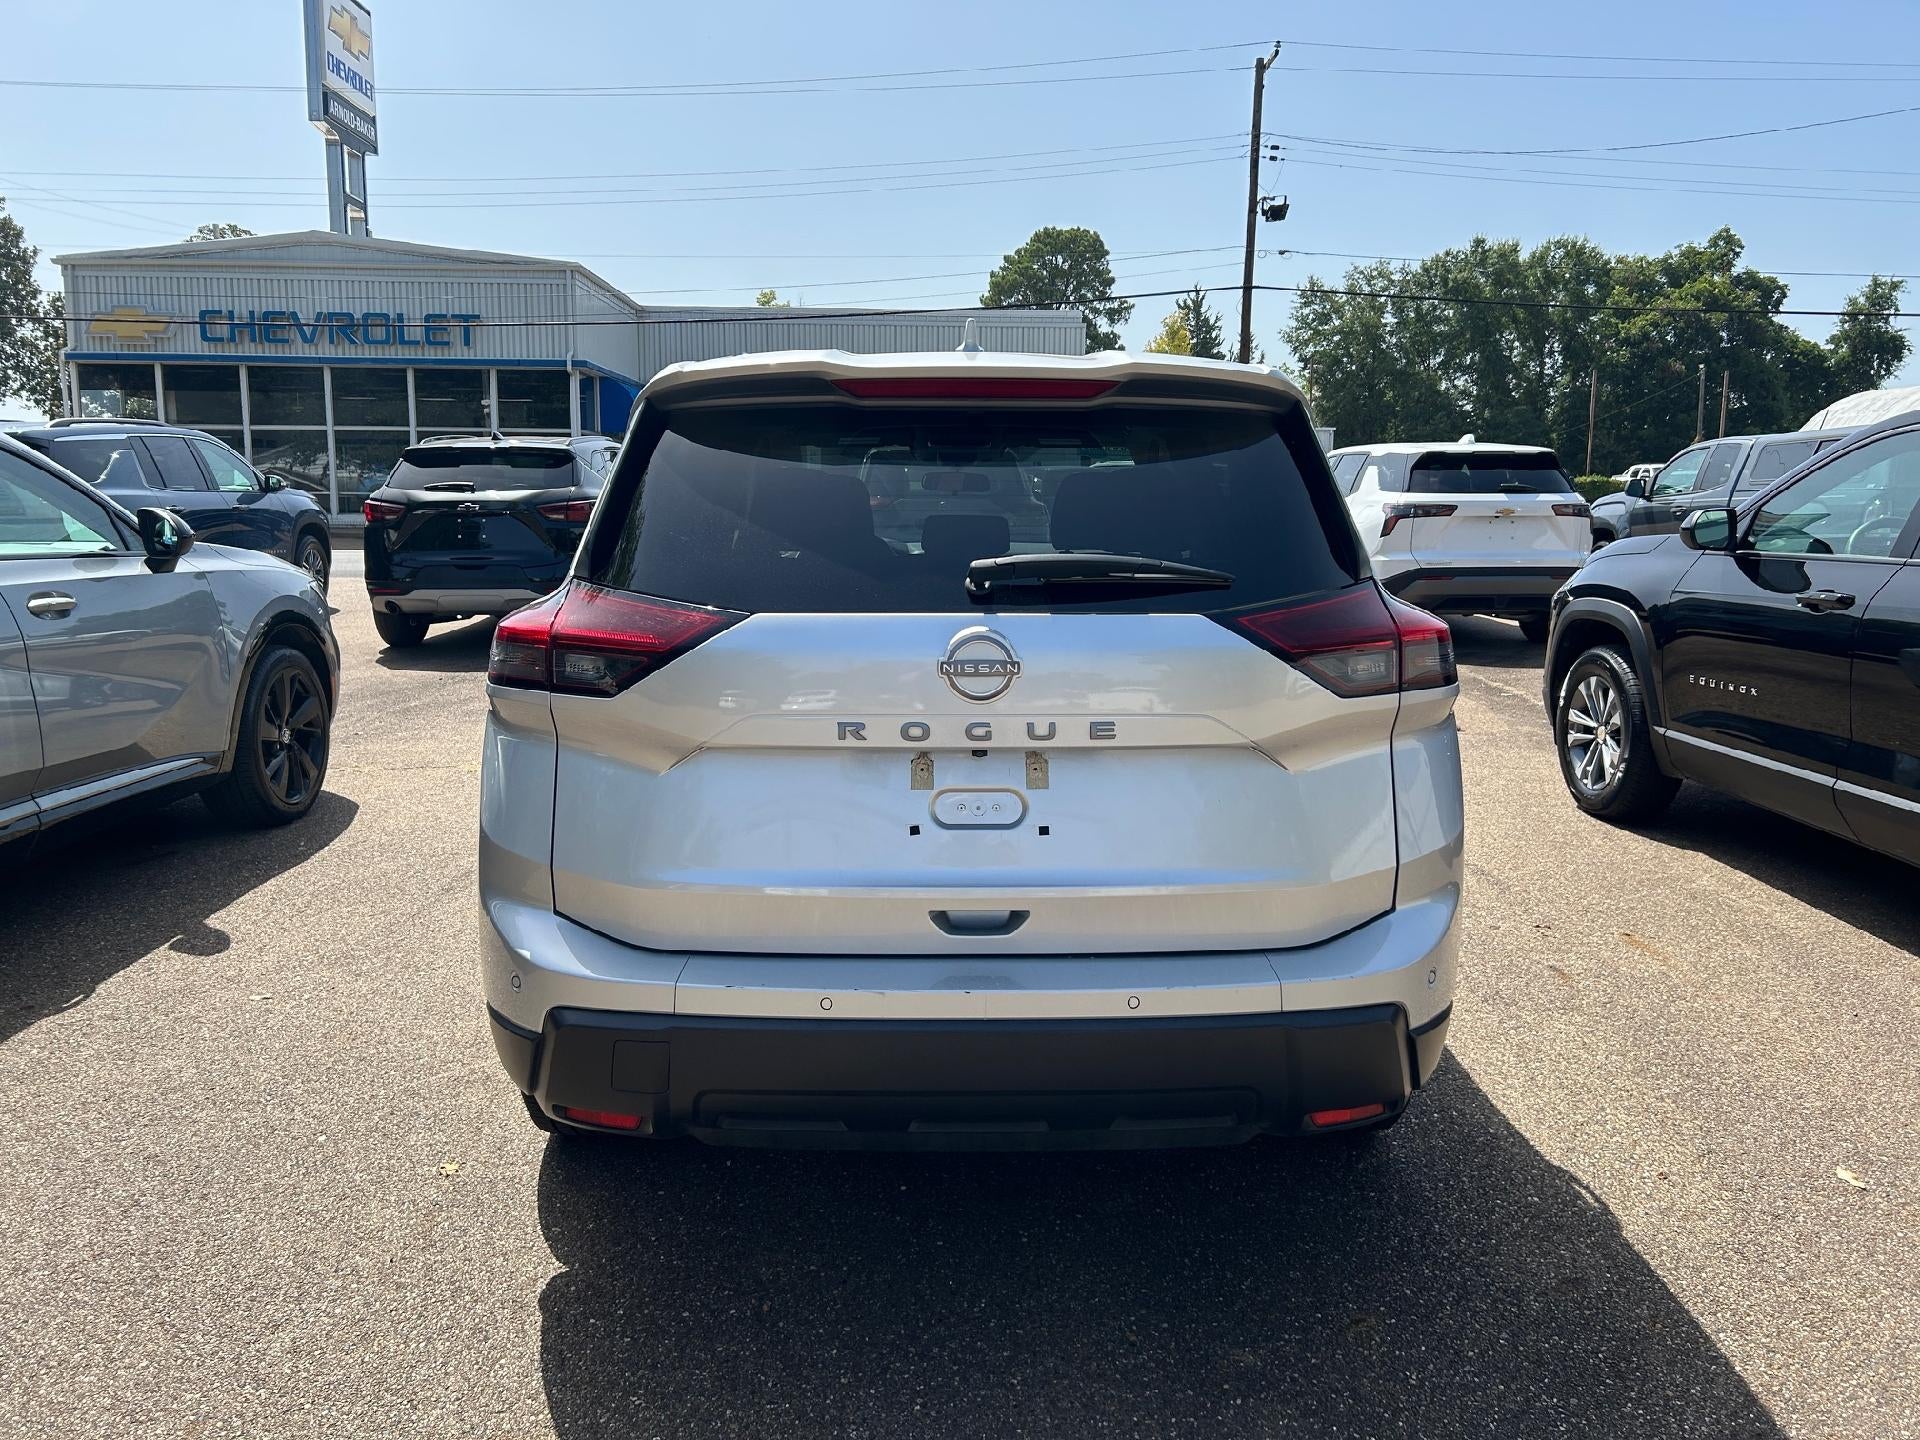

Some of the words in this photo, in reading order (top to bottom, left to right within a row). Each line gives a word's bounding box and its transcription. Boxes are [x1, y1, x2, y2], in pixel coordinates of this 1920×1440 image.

[327, 51, 374, 101] CHEVROLET
[330, 99, 375, 141] ARNOLD-BAKER
[199, 309, 481, 347] CHEVROLET
[943, 664, 1018, 673] NISSAN
[1689, 675, 1757, 695] EQUINOX
[837, 721, 1117, 741] ROGUE
